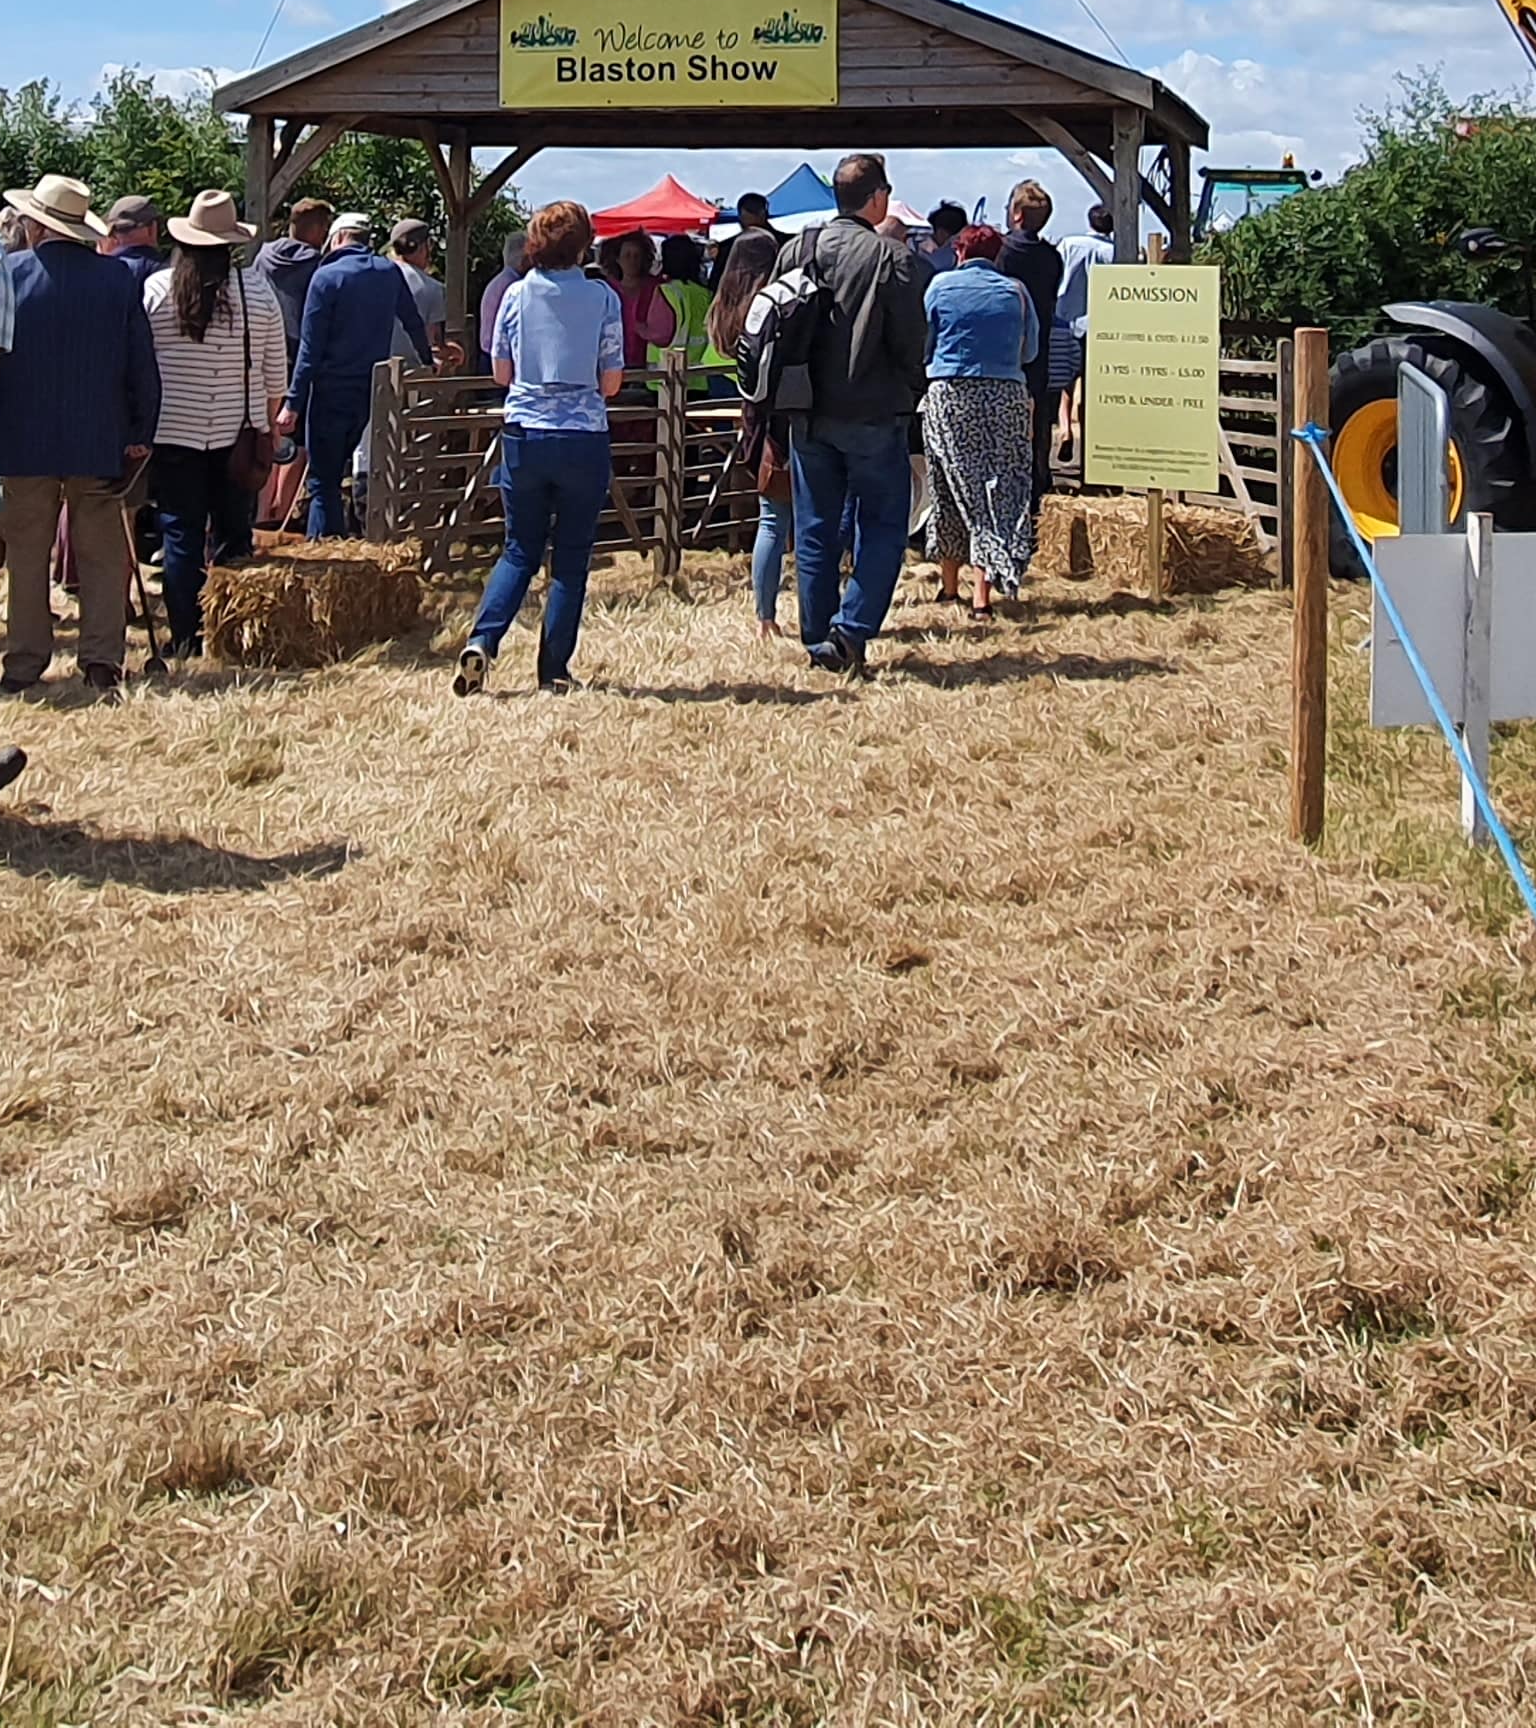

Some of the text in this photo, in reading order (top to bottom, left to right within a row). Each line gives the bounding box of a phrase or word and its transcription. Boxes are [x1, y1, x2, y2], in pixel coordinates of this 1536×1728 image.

[594, 22, 706, 52] Welcome
[717, 24, 739, 50] to
[556, 55, 778, 82] Blaston Show
[1108, 286, 1199, 303] ADMISSION
[1183, 398, 1204, 409] FREE
